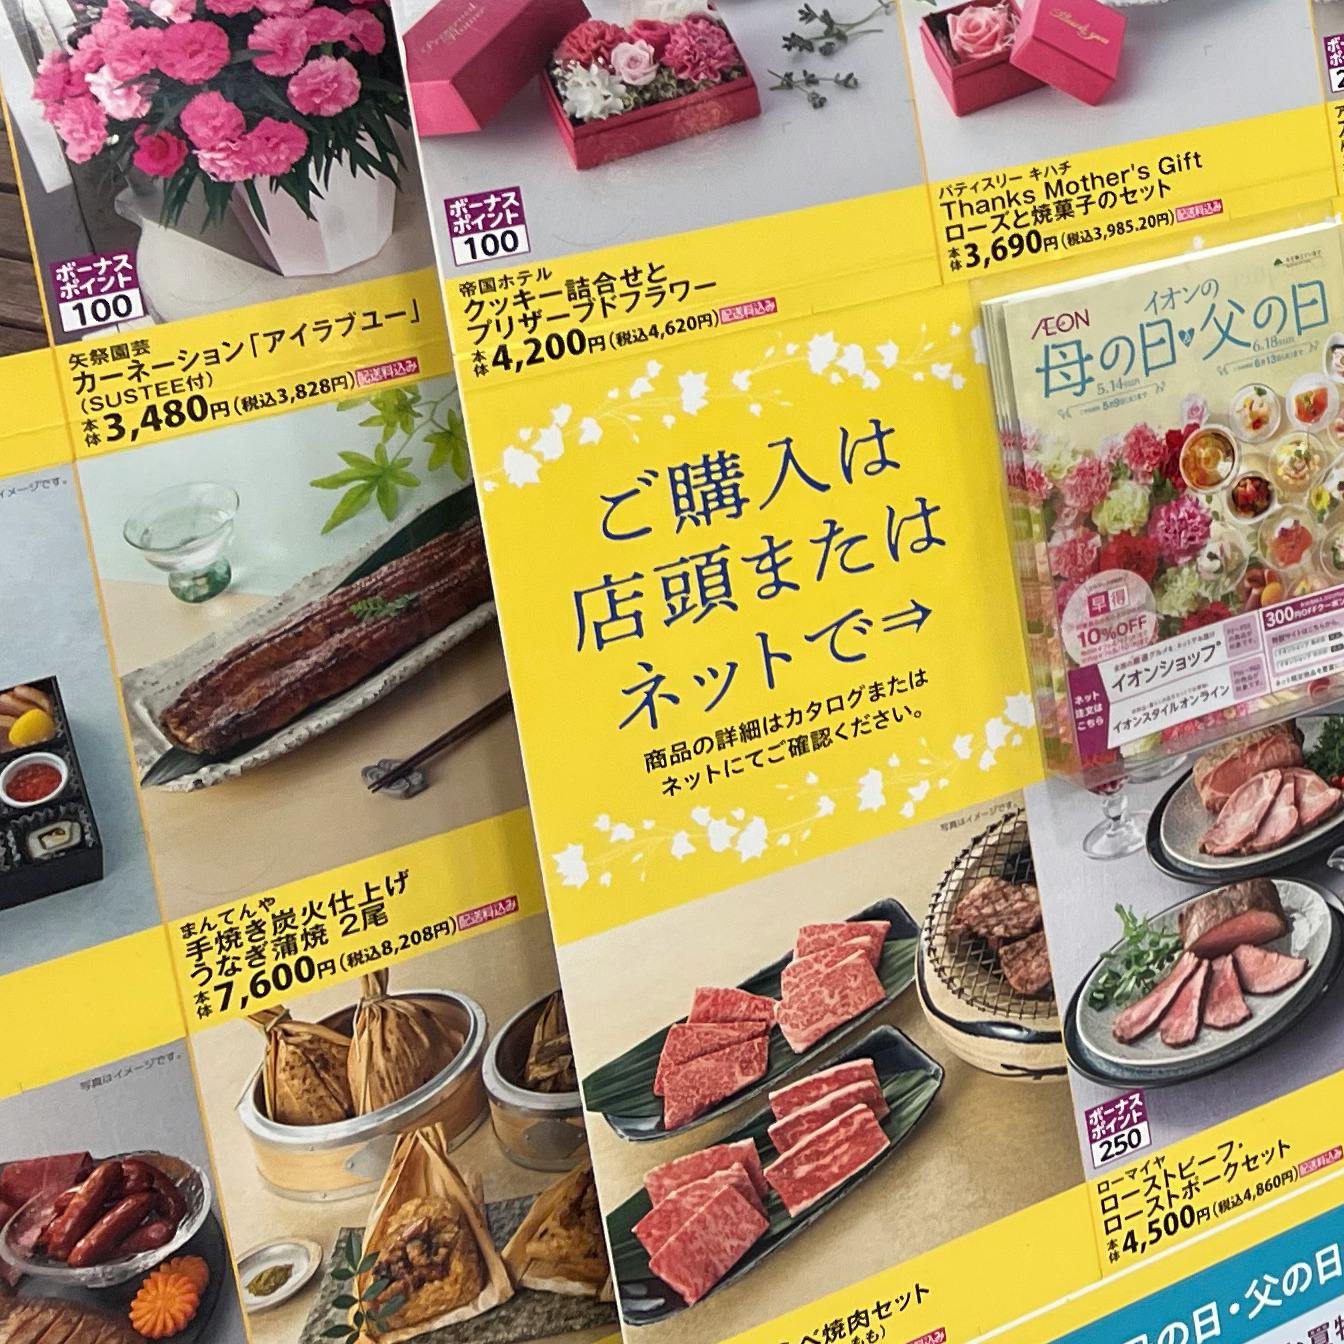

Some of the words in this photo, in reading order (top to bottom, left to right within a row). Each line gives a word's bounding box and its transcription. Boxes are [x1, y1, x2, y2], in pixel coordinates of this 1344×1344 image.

[939, 174, 1022, 199] パティスリー
[1029, 161, 1072, 181] キハチ
[940, 188, 1035, 220] Thanks
[1044, 164, 1151, 199] Mother's
[1159, 151, 1202, 174] Gift
[946, 179, 1171, 242] ローズと焼菓子のセット
[464, 230, 519, 259] 100
[56, 254, 133, 280] ボーナス
[60, 274, 132, 300] ポイント
[459, 267, 552, 297] 帝国ホテル
[72, 294, 133, 327] 100
[463, 261, 669, 322] クッキー詰合せと
[467, 281, 717, 344] プリザーブドフラワー
[719, 297, 777, 325] 配送料込み
[1144, 279, 1219, 316] イオンの
[69, 339, 151, 370] 矢祭園芸
[74, 298, 420, 395] カーネーション「アイラブユー」
[80, 372, 213, 415] (SUSTEE付)
[355, 357, 420, 389] 配送料込み
[600, 418, 901, 541] ご購入は
[573, 497, 948, 652] 店頭または
[1077, 615, 1148, 647] 10%OFF
[1111, 640, 1222, 693] イオンショップ
[643, 668, 929, 774] 商品の詳細はカタログまたは
[661, 707, 922, 798] ネットにてご確認ください。
[179, 897, 276, 940] まんてんや
[185, 869, 410, 963] 手焼き炭火仕上げ
[456, 896, 519, 932] 配送料込み
[189, 930, 330, 986] うなぎ蒲焼
[339, 902, 390, 941] 2尾
[1099, 1128, 1142, 1162] 250
[1098, 1155, 1167, 1195] ローマイヤ
[1104, 1139, 1291, 1236] ローストポークセット
